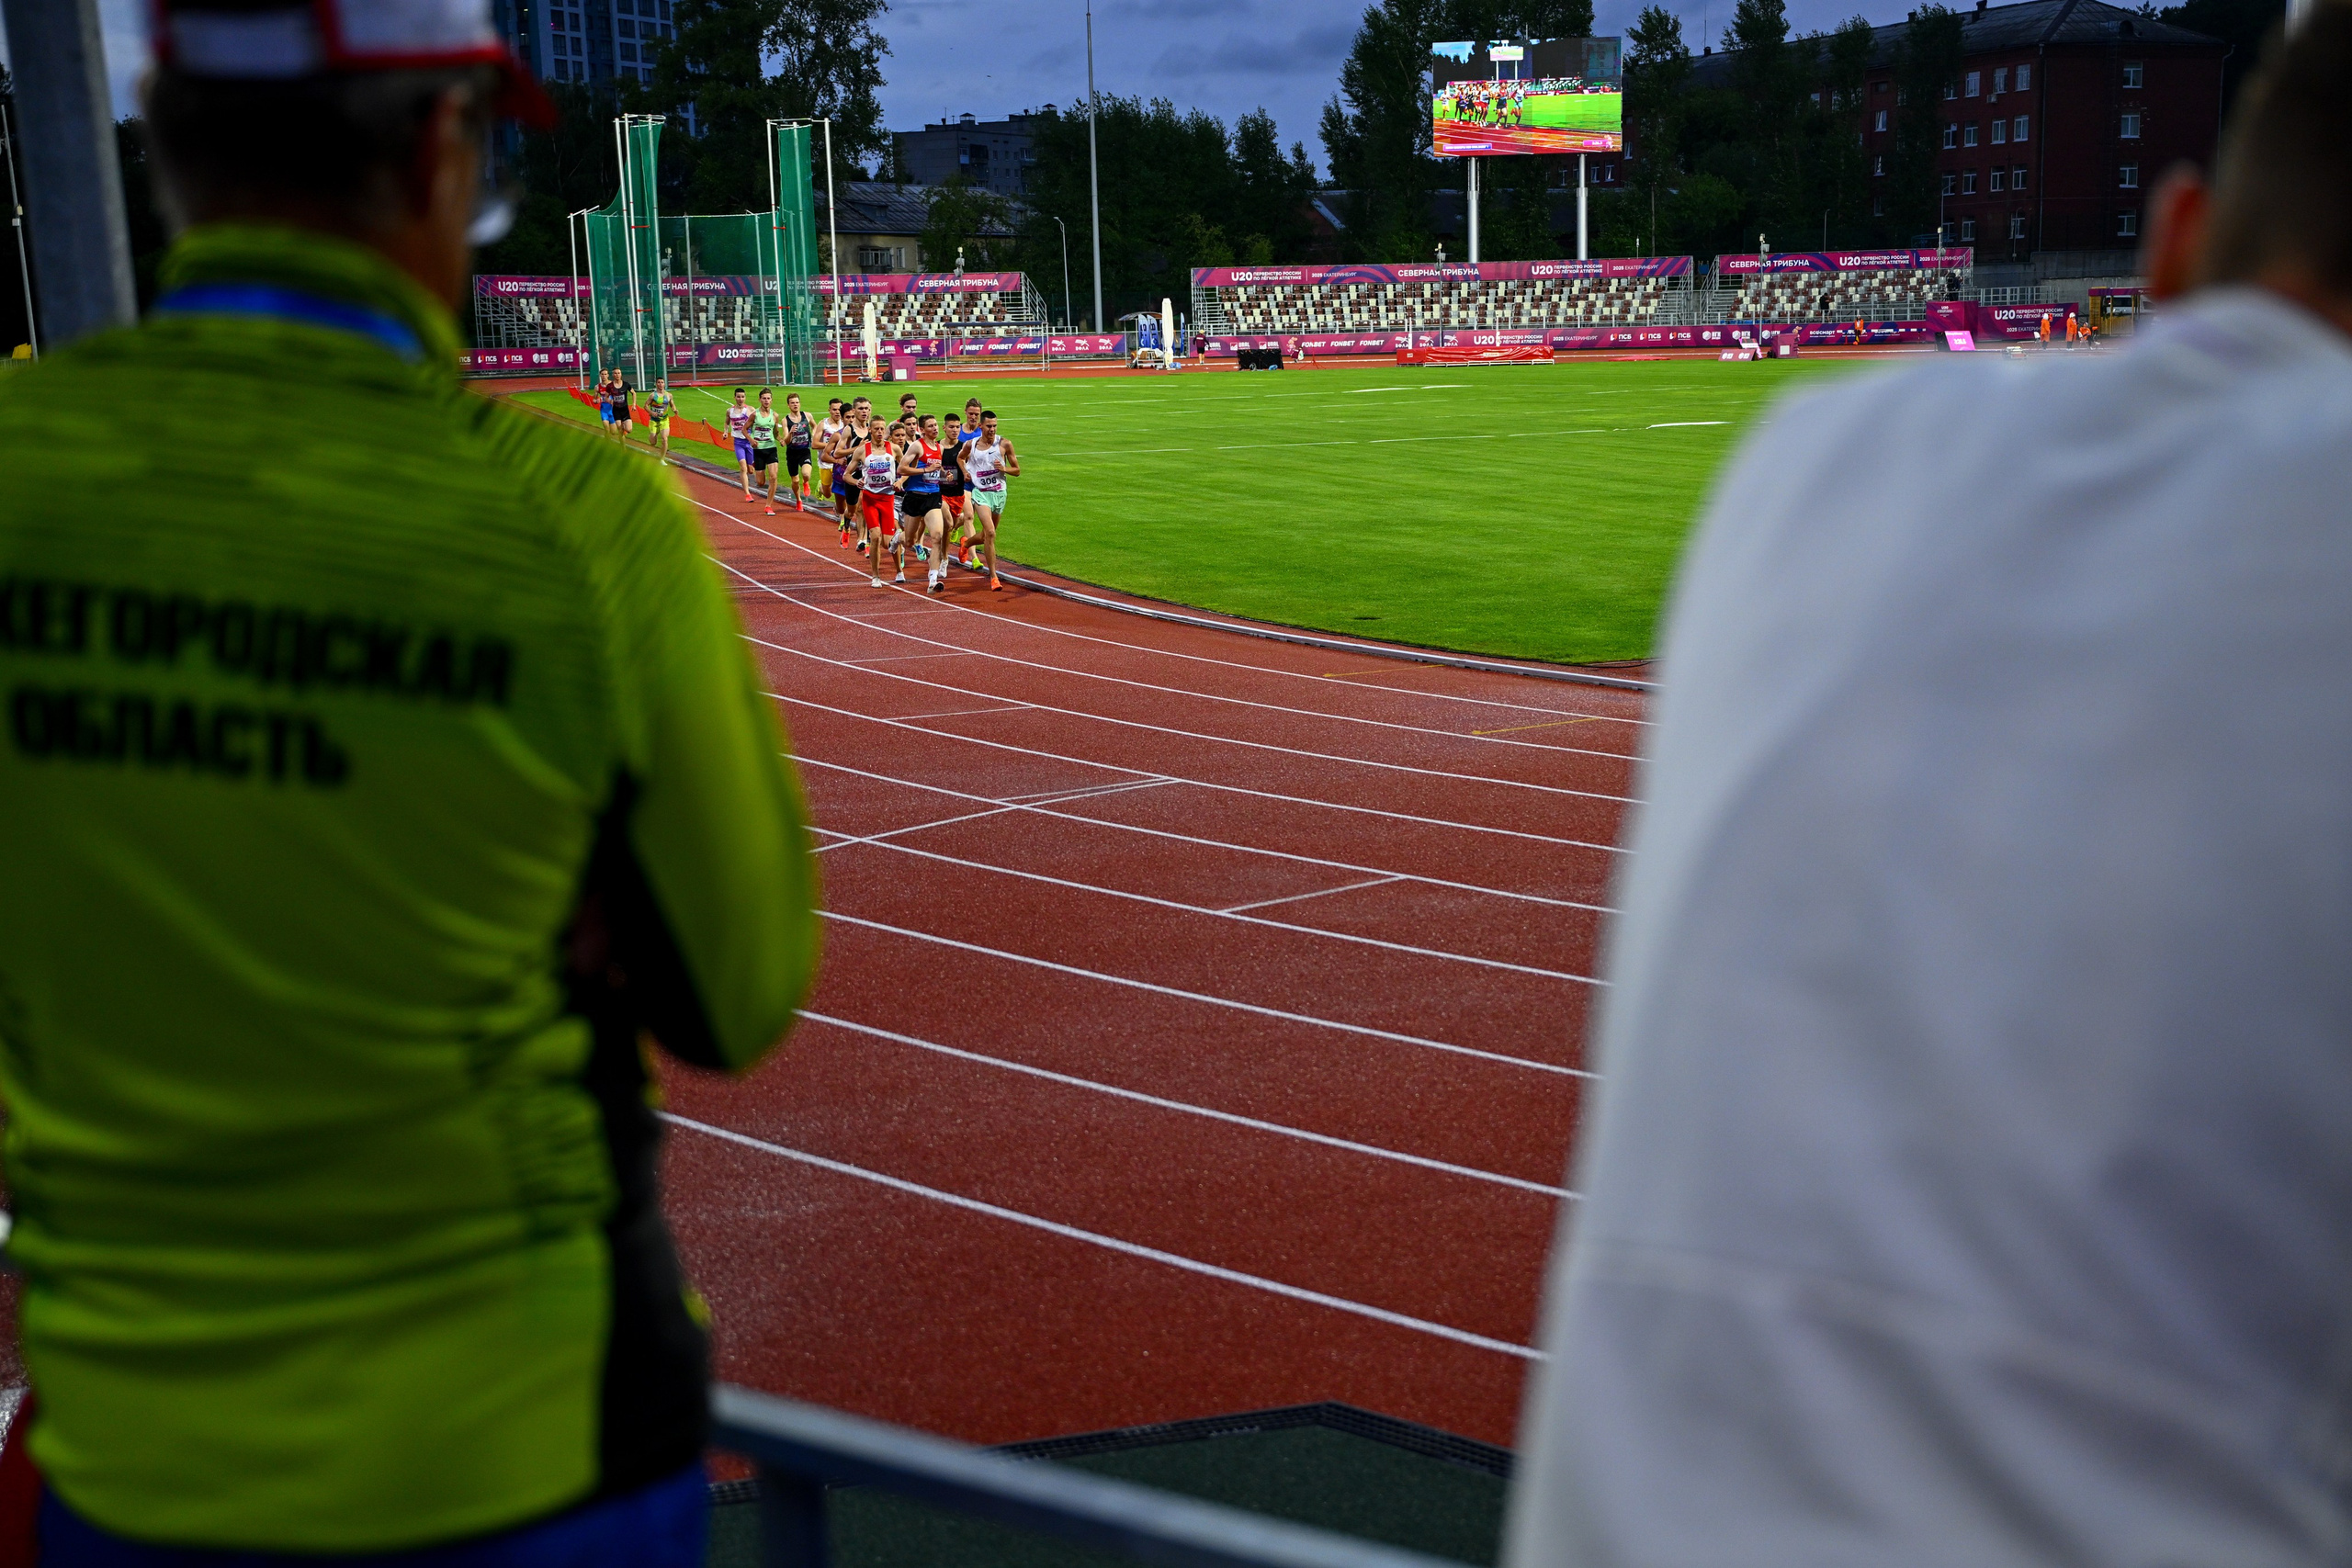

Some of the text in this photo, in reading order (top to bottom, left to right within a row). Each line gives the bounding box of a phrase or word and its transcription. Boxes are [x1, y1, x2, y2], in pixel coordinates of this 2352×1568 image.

[1773, 259, 1810, 267] ТРИБУНА
[1839, 256, 1860, 266] U20
[1532, 265, 1554, 275] U20
[1231, 272, 1252, 281] U20
[498, 281, 518, 292] U20
[691, 282, 726, 290] ТРИБУНА
[764, 280, 778, 290] U2
[919, 278, 999, 288] СЕВЕРНАЯ ТРИБУНА
[1995, 310, 2015, 320] U20
[1474, 335, 1494, 344] U20
[718, 349, 739, 358] U20
[980, 477, 997, 485] 308
[13, 683, 351, 787] ОБЛАСТЬ
